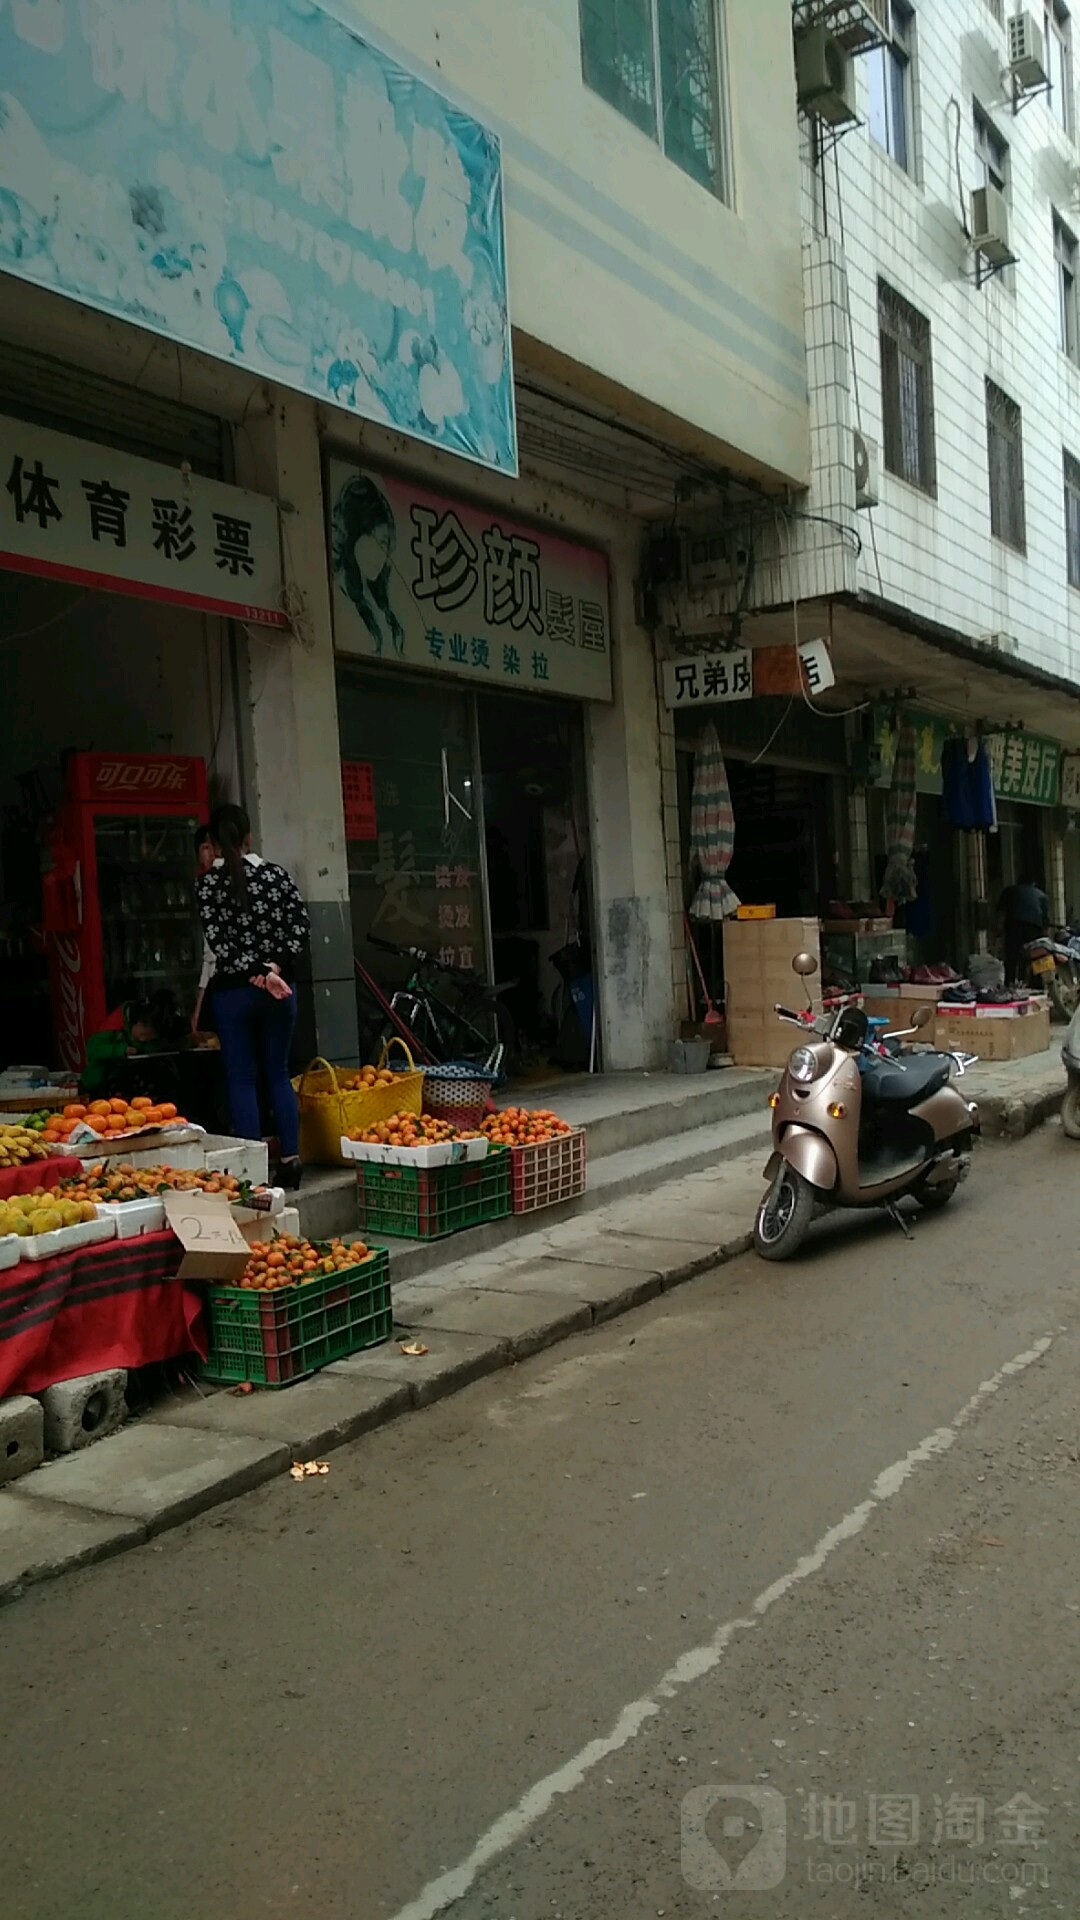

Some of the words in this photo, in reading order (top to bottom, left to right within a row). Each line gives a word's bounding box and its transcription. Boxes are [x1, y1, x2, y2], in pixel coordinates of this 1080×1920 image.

[6, 455, 255, 576] 体育彩票
[410, 504, 544, 635] 珍颜
[424, 626, 550, 681] 专业烫染拉
[95, 761, 191, 792] 可口可乐
